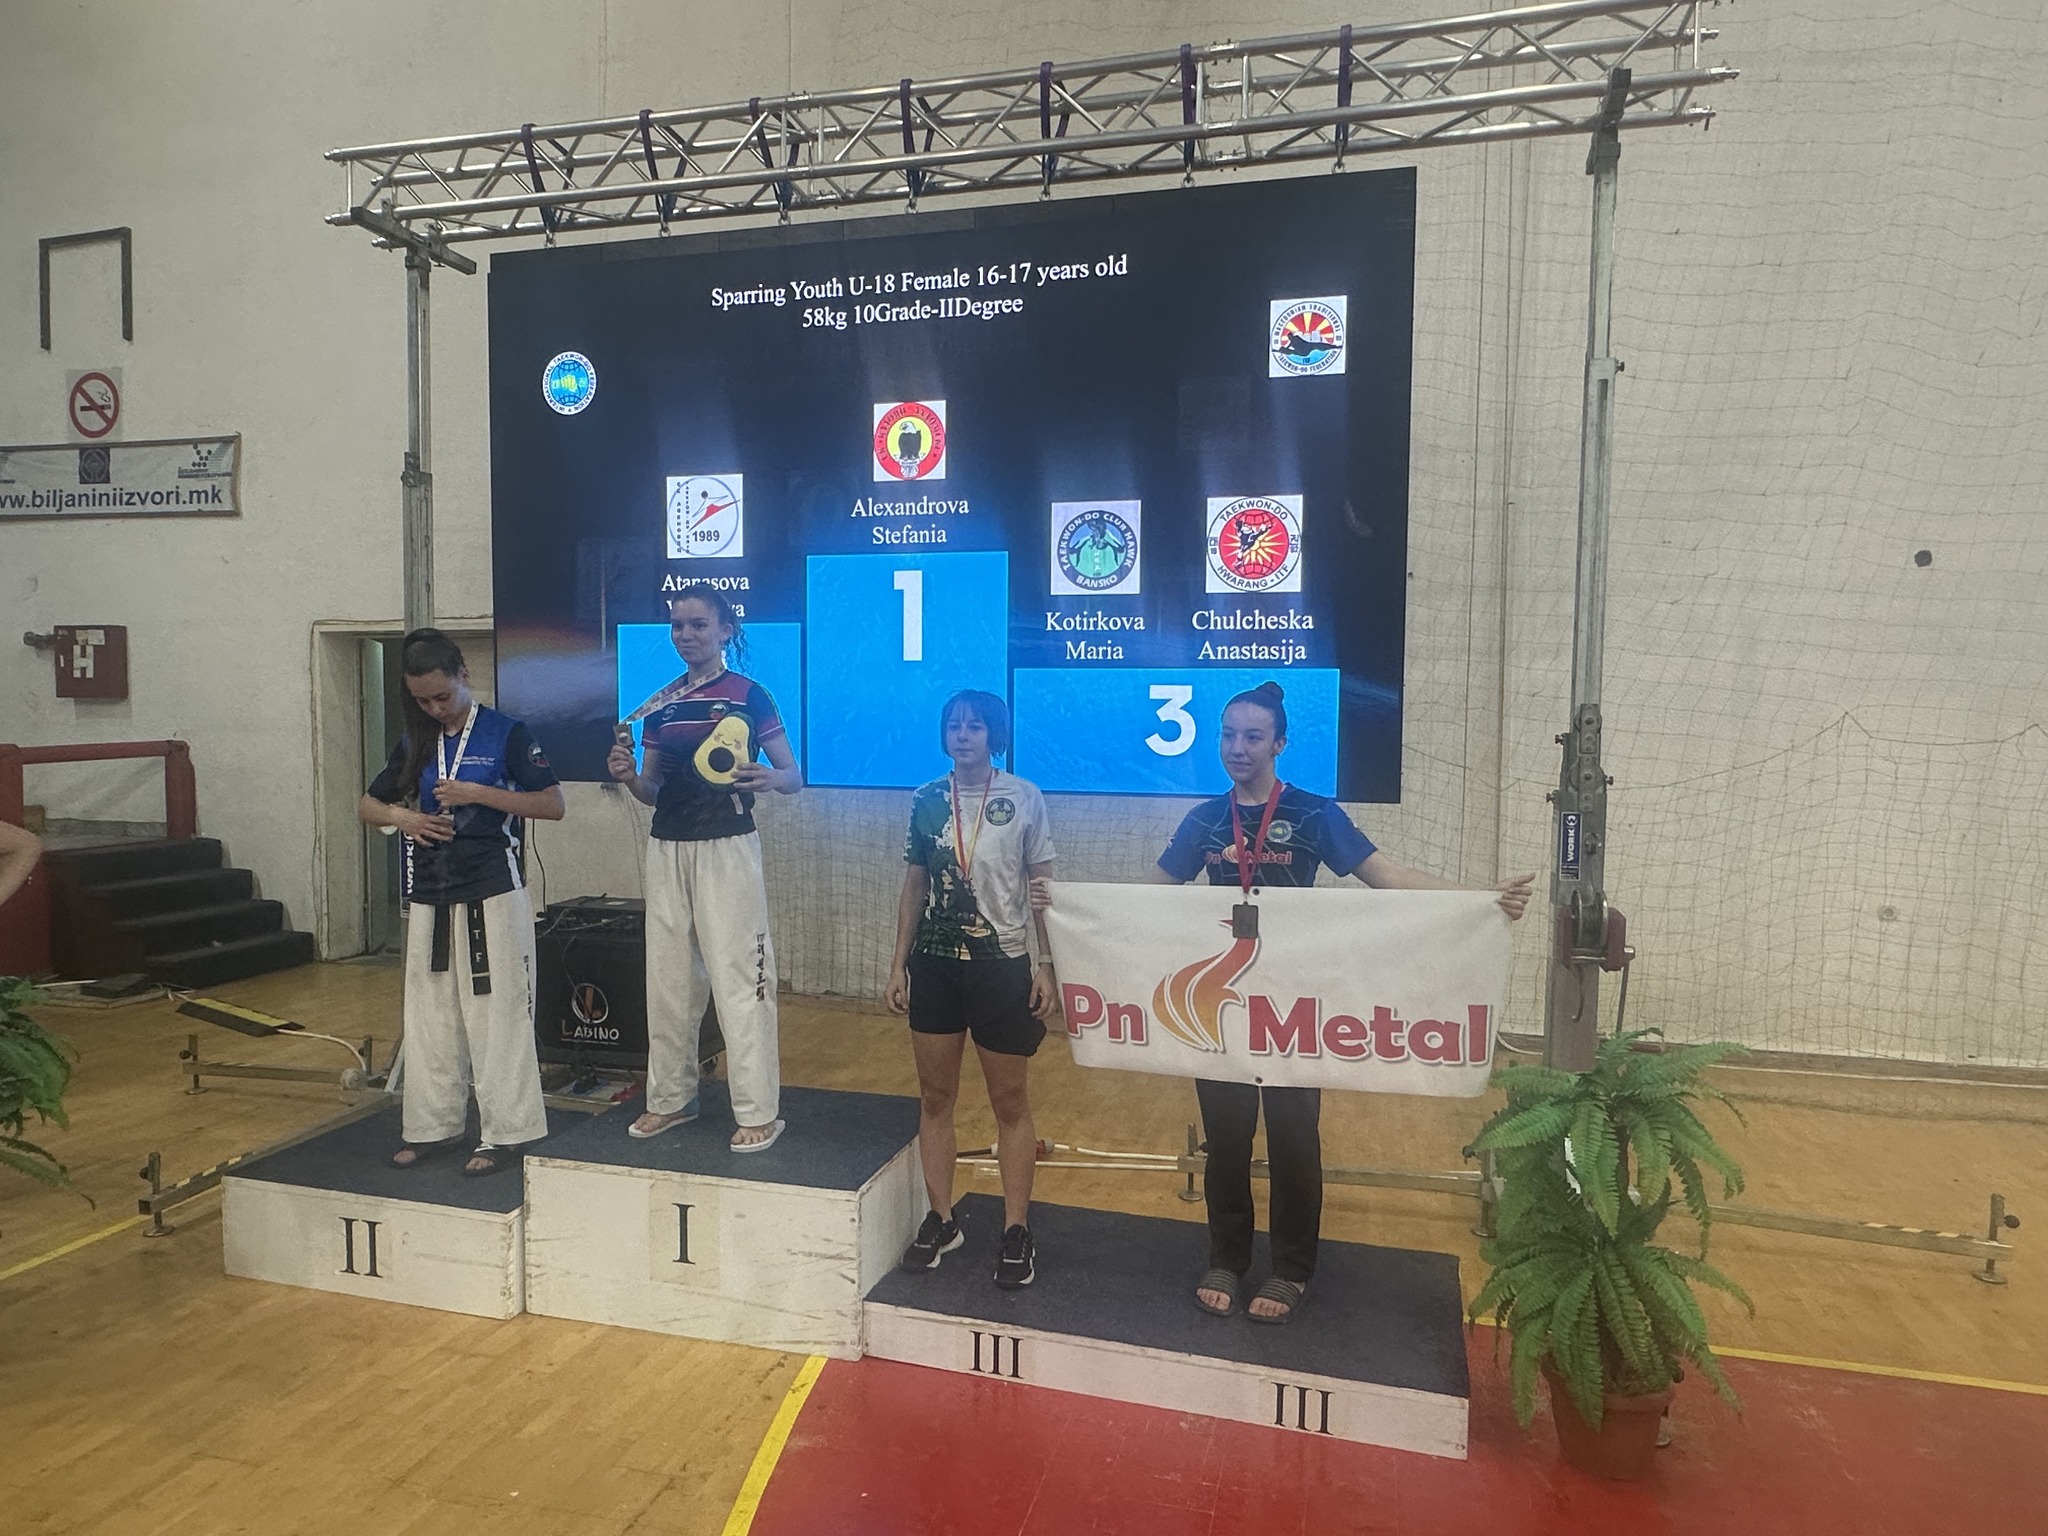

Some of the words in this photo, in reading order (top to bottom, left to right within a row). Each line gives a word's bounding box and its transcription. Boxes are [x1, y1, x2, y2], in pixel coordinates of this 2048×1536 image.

[711, 284, 786, 310] Sparring
[793, 279, 843, 301] Youth
[848, 273, 895, 295] U-18
[900, 267, 970, 292] Female
[977, 262, 1031, 286] 16-17
[1036, 261, 1089, 286] years
[1094, 254, 1128, 278] old
[802, 306, 847, 330] 58kg
[853, 296, 1023, 325] 10Grade-IIDegree
[851, 496, 969, 518] Alexandrova
[1219, 500, 1288, 521] TAEKWON-DO
[692, 530, 720, 542] 1989
[872, 526, 947, 545] Stefania
[1060, 512, 1100, 571] TAEKWON-DO
[1103, 513, 1127, 533] CLUB
[1124, 531, 1136, 568] HAWK
[1076, 575, 1118, 588] BANSKO
[1217, 565, 1268, 589] HWARANG
[1274, 563, 1290, 580] ITF
[893, 570, 923, 662] 1
[1045, 610, 1145, 631] Kotirkova
[1191, 608, 1314, 630] Chulcheska
[1065, 639, 1124, 660] Maria
[1197, 637, 1307, 665] Anastasija
[1144, 684, 1197, 757] 3
[1566, 828, 1576, 863] WORK
[561, 1019, 620, 1041] LABINO
[1061, 982, 1150, 1046] Pn
[1247, 994, 1494, 1066] Metal
[338, 1216, 383, 1278] II
[671, 1202, 696, 1265] I
[969, 1330, 1024, 1379] III
[1271, 1382, 1335, 1436] III
